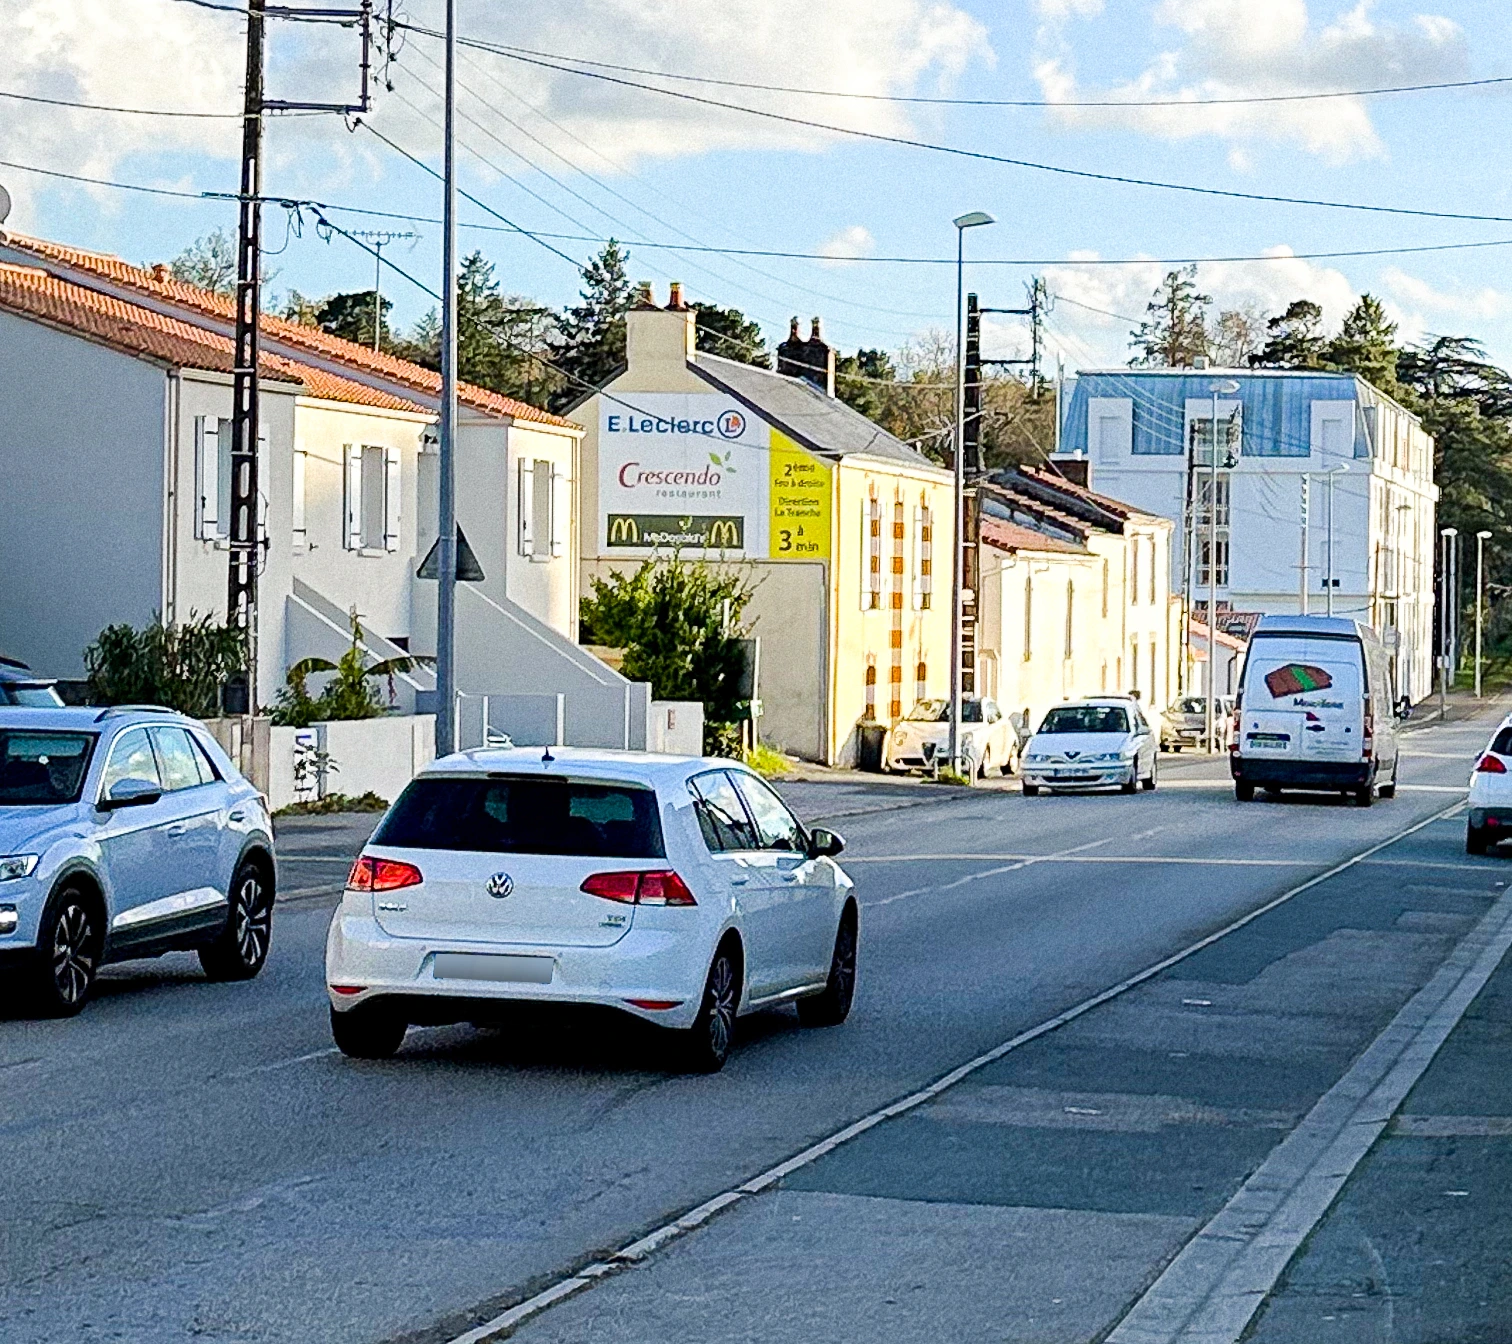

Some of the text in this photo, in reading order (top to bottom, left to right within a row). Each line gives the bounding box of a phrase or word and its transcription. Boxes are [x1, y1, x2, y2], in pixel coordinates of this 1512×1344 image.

[608, 416, 714, 434] E.Leclerc
[618, 462, 721, 488] Crescendo
[656, 490, 721, 499] restaurant
[779, 530, 792, 551] 3
